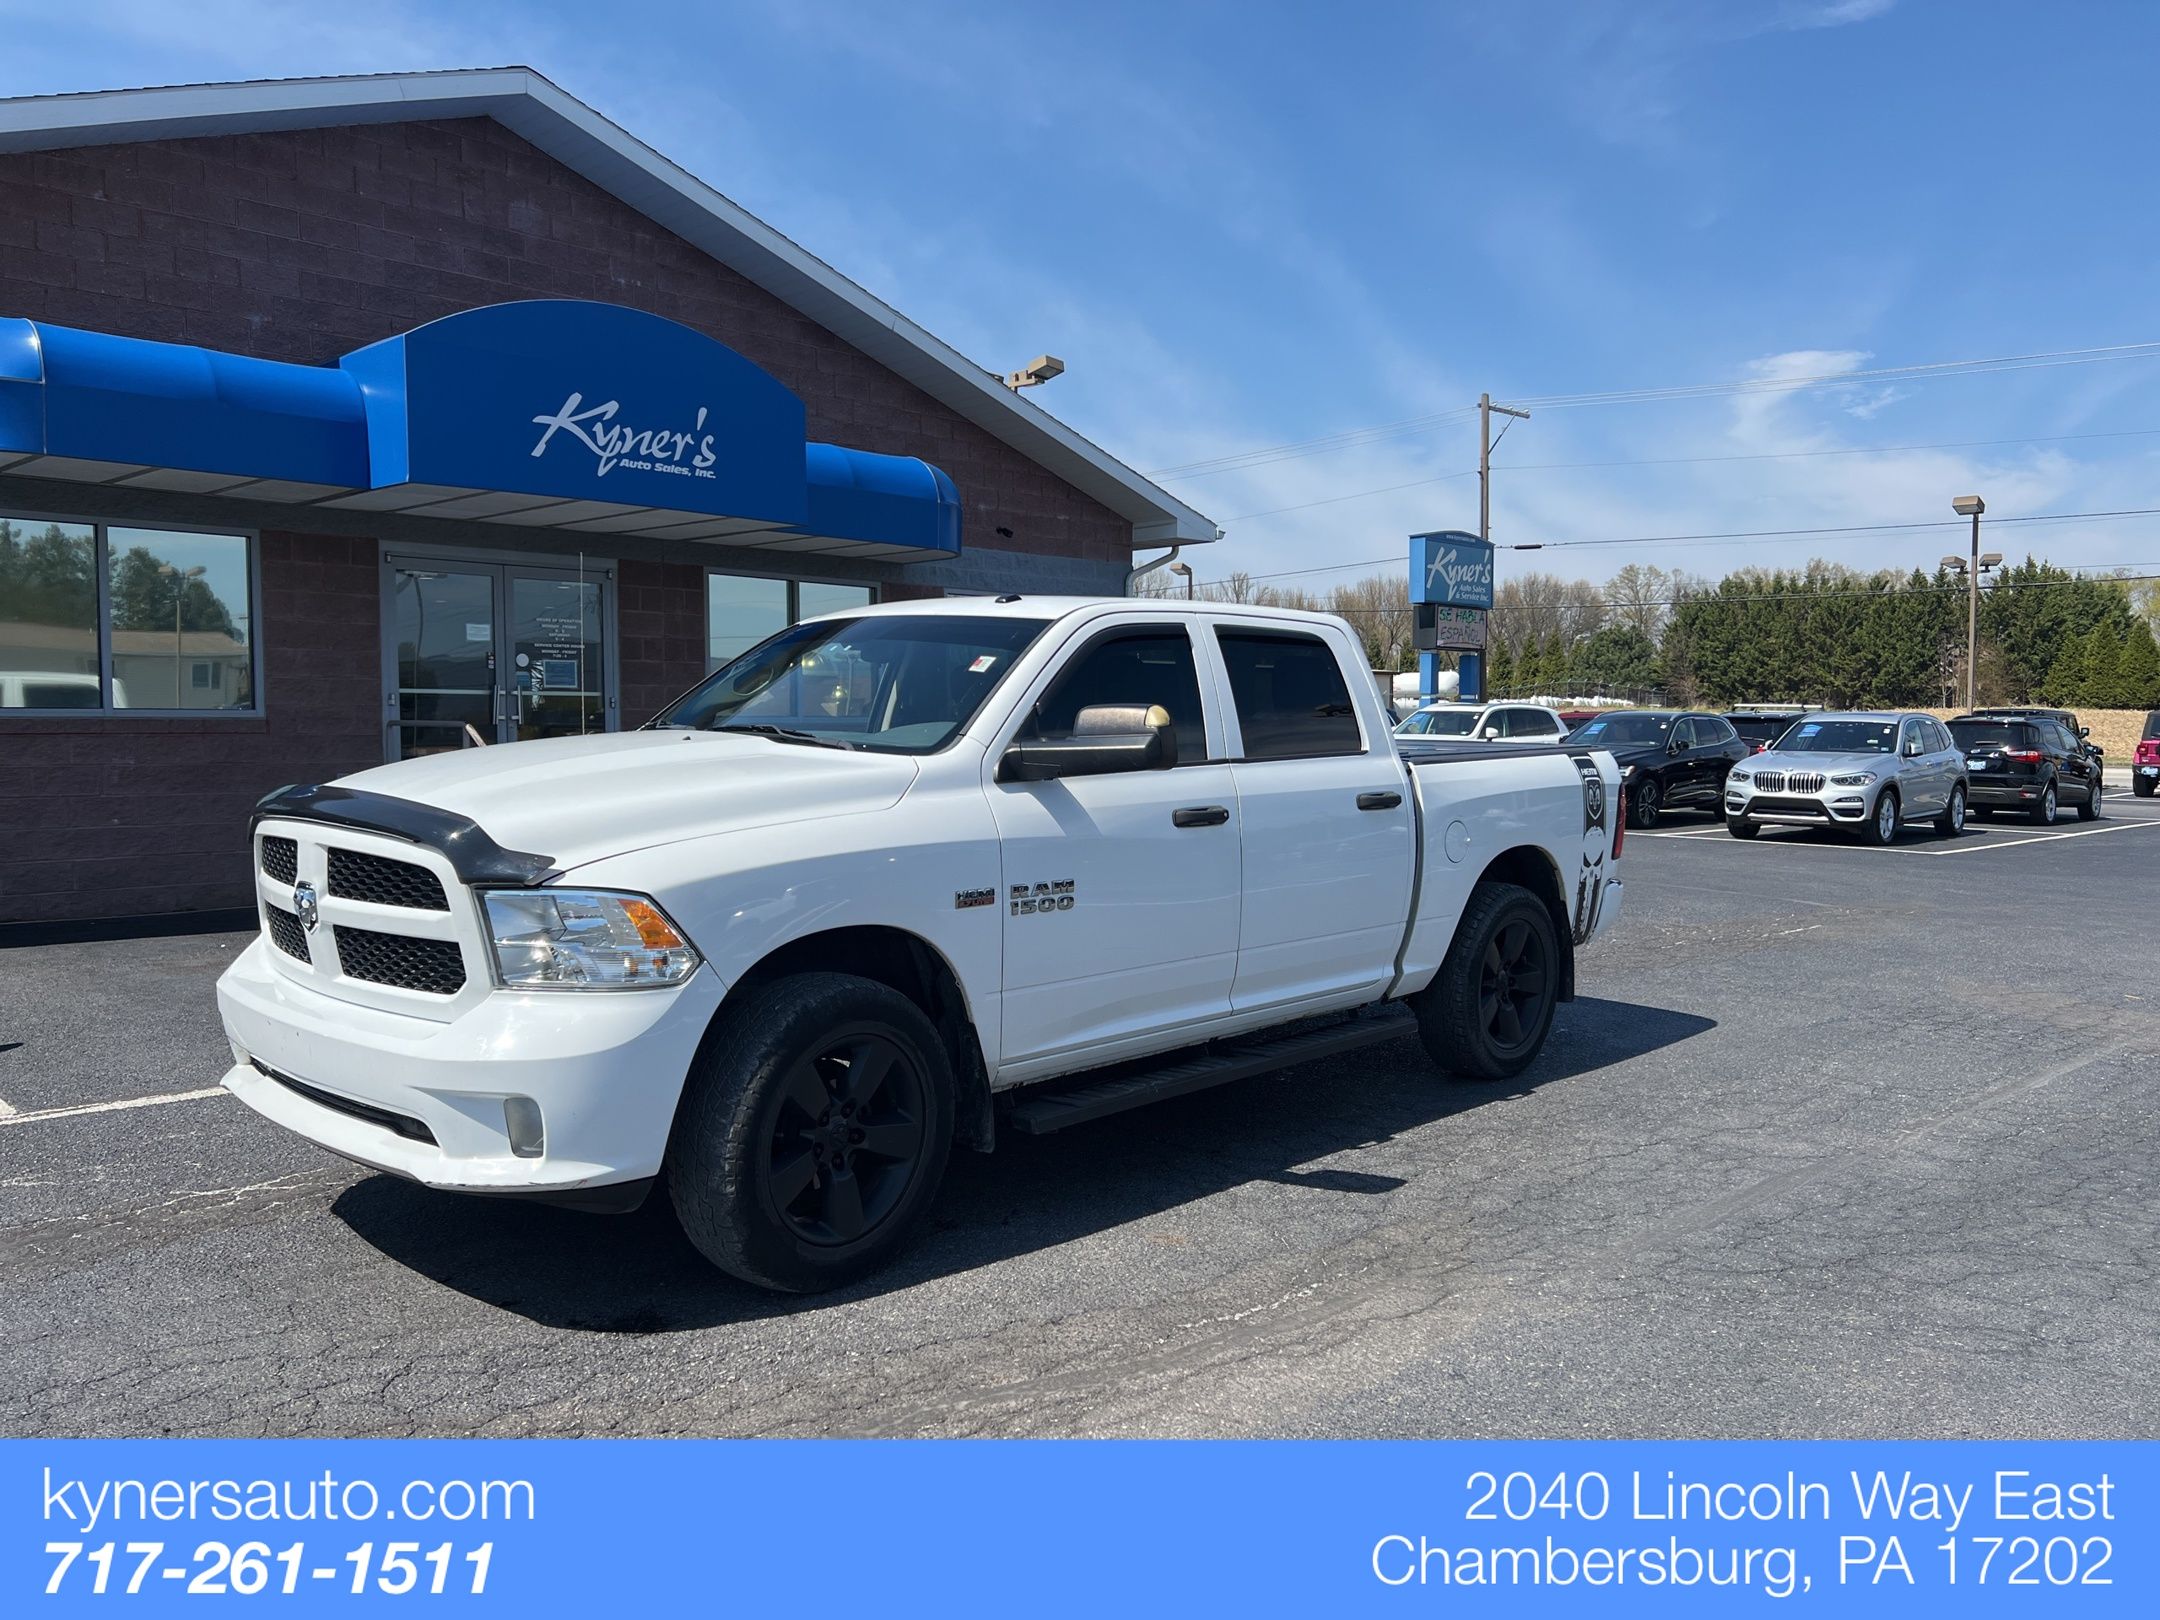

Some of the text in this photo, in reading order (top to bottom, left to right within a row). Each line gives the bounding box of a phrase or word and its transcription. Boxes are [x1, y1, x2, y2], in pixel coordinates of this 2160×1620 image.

[531, 392, 716, 477] Kyner's
[619, 458, 717, 479] Auto Sales, Inc.
[1427, 546, 1491, 601] Kyner's
[1460, 584, 1487, 593] Auto Sales
[1460, 591, 1480, 601] Service
[1439, 608, 1485, 625] SE HABLA
[1581, 767, 1598, 776] HEMI
[955, 887, 995, 900] HEMI
[1010, 878, 1075, 899] RAM
[1009, 895, 1075, 916] 1500
